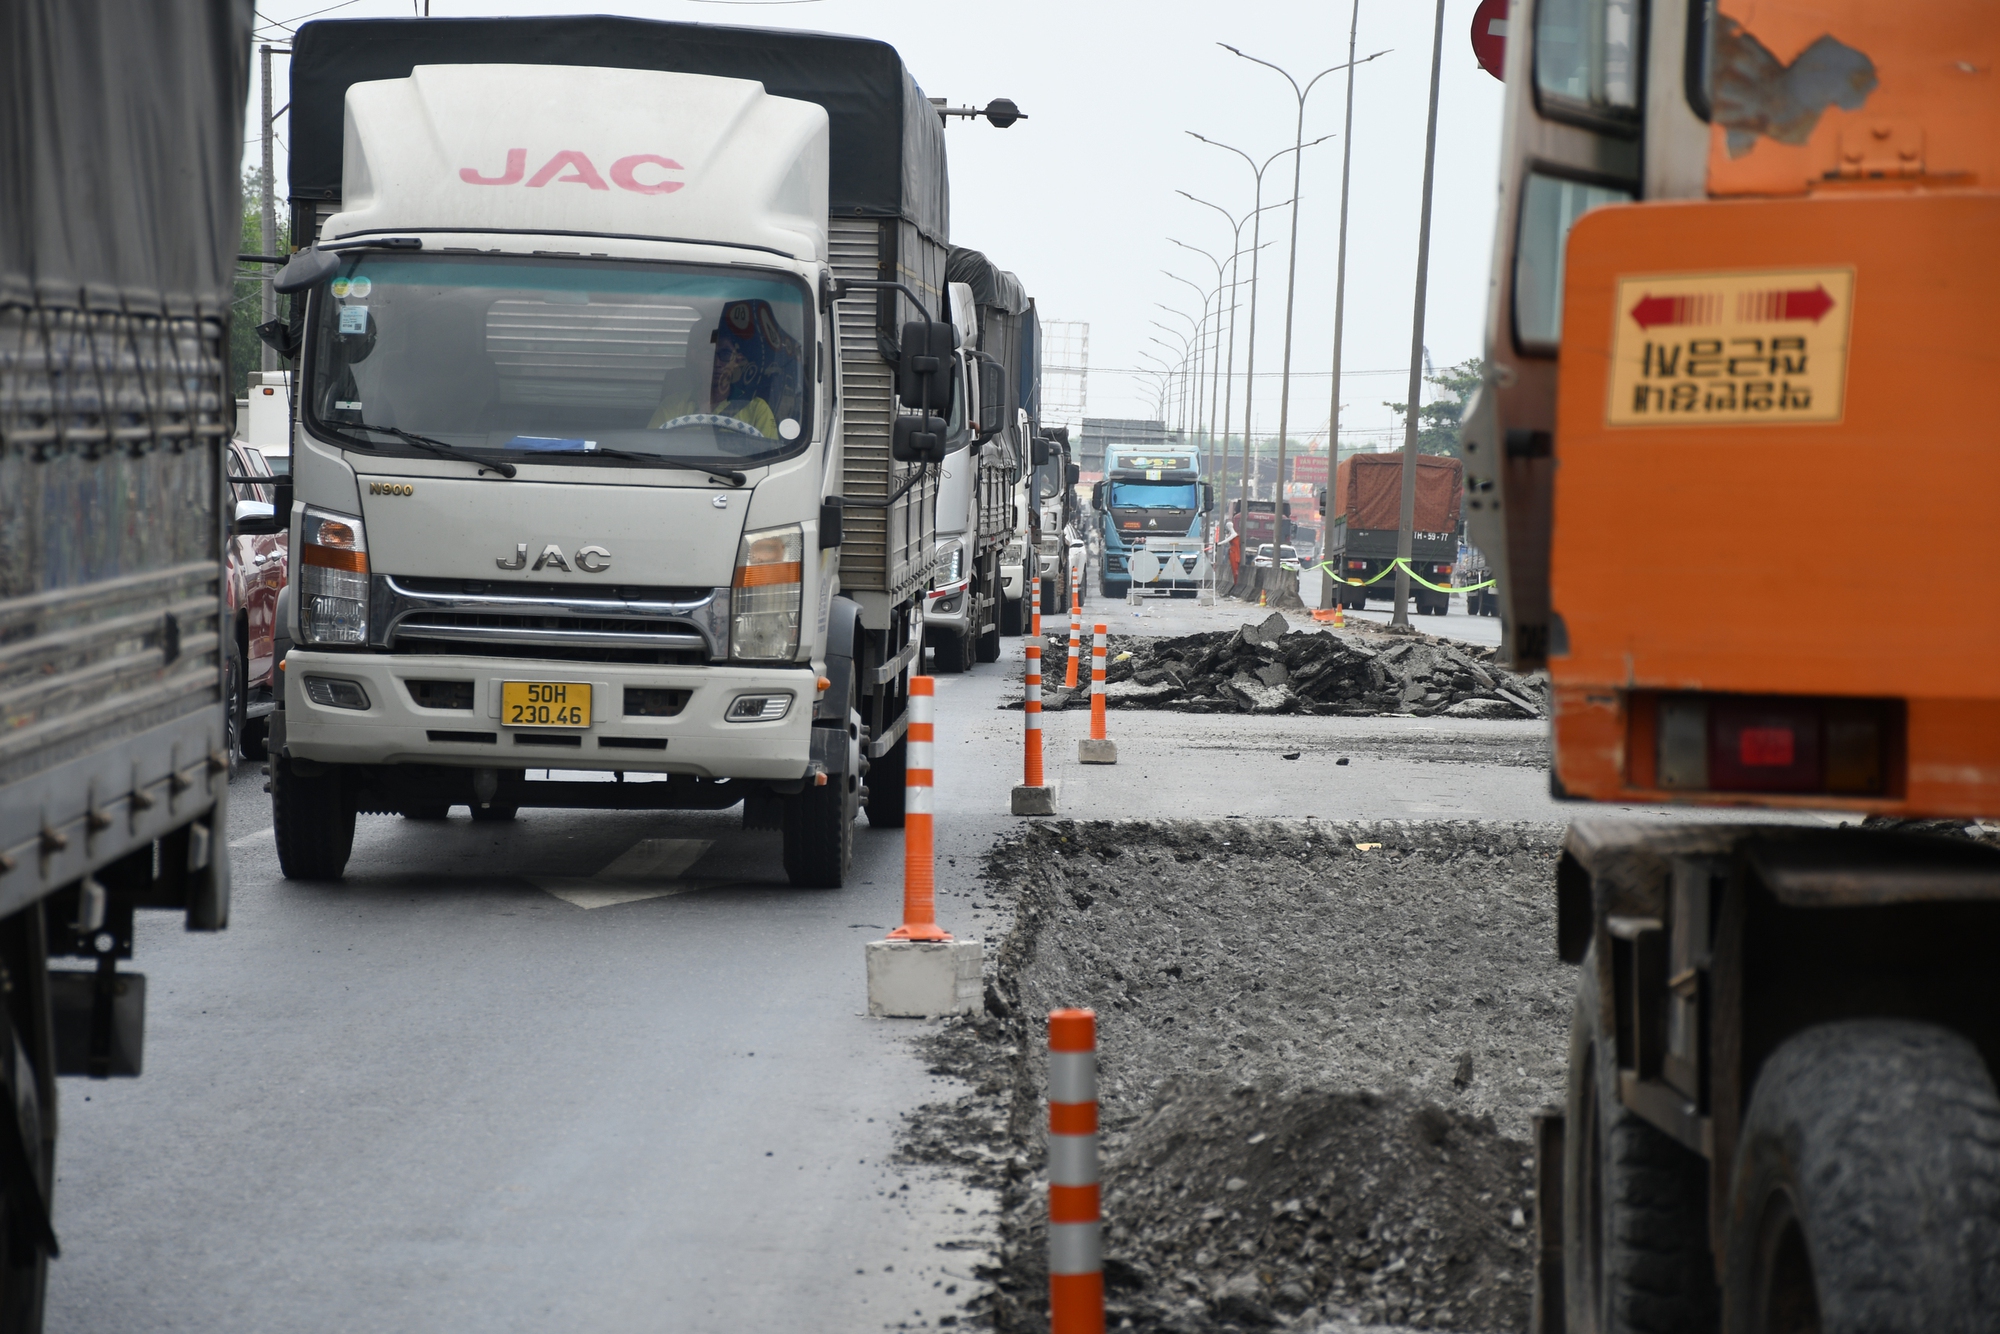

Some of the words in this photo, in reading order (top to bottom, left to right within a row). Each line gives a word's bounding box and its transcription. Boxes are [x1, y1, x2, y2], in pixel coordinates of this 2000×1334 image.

[459, 148, 685, 195] JAC
[1643, 337, 1808, 378] 접근금지
[370, 482, 414, 496] N900
[496, 543, 611, 573] JAC
[528, 684, 566, 703] 50H
[511, 705, 582, 724] 230.46
